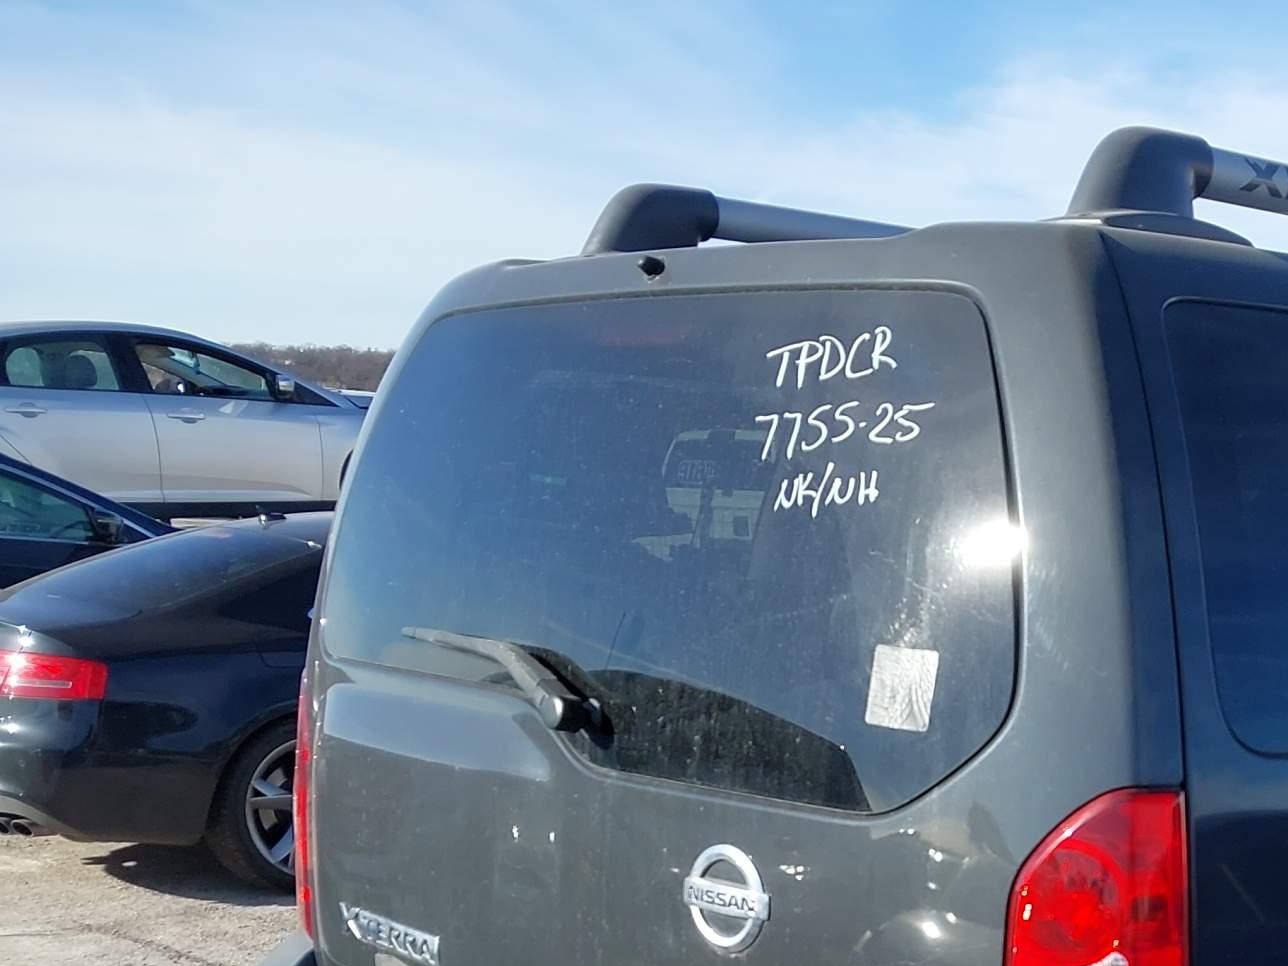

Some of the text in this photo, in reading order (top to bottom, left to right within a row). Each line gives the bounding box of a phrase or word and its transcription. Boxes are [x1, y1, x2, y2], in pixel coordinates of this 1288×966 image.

[766, 326, 898, 389] TPDCR
[755, 400, 936, 461] 7755-25
[688, 885, 756, 912] NISSAN
